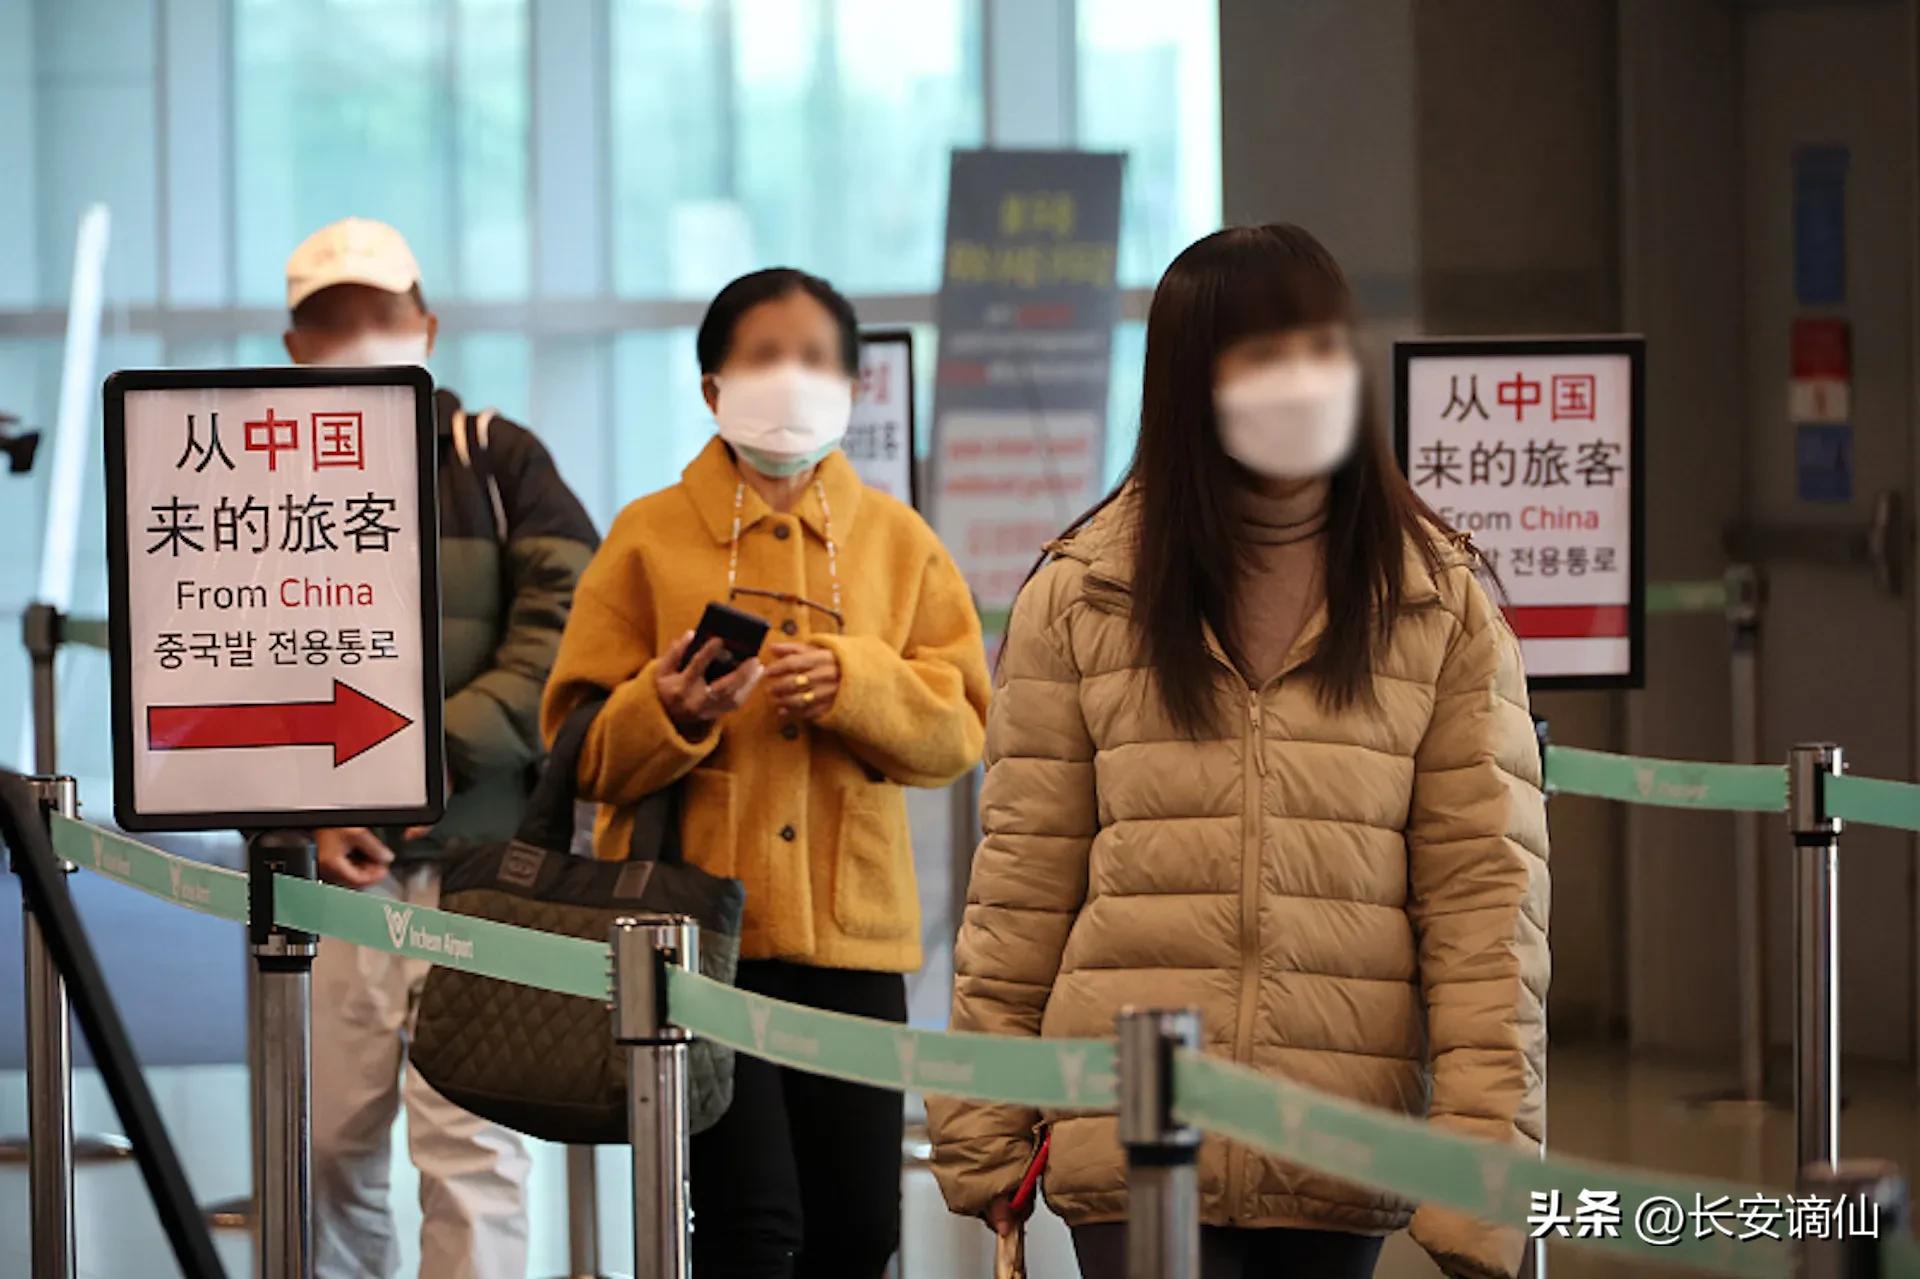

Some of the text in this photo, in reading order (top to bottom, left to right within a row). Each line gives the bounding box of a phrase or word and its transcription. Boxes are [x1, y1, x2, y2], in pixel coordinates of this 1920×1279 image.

[1441, 371, 1597, 423] 从中国
[176, 408, 365, 473] 从中国
[1414, 439, 1625, 490] 来的旅客
[146, 491, 401, 557] 来的旅客
[1519, 505, 1600, 531] China
[1510, 546, 1617, 577] 전용통로
[177, 576, 374, 610] From China
[153, 627, 400, 670] 중국발 전용통로
